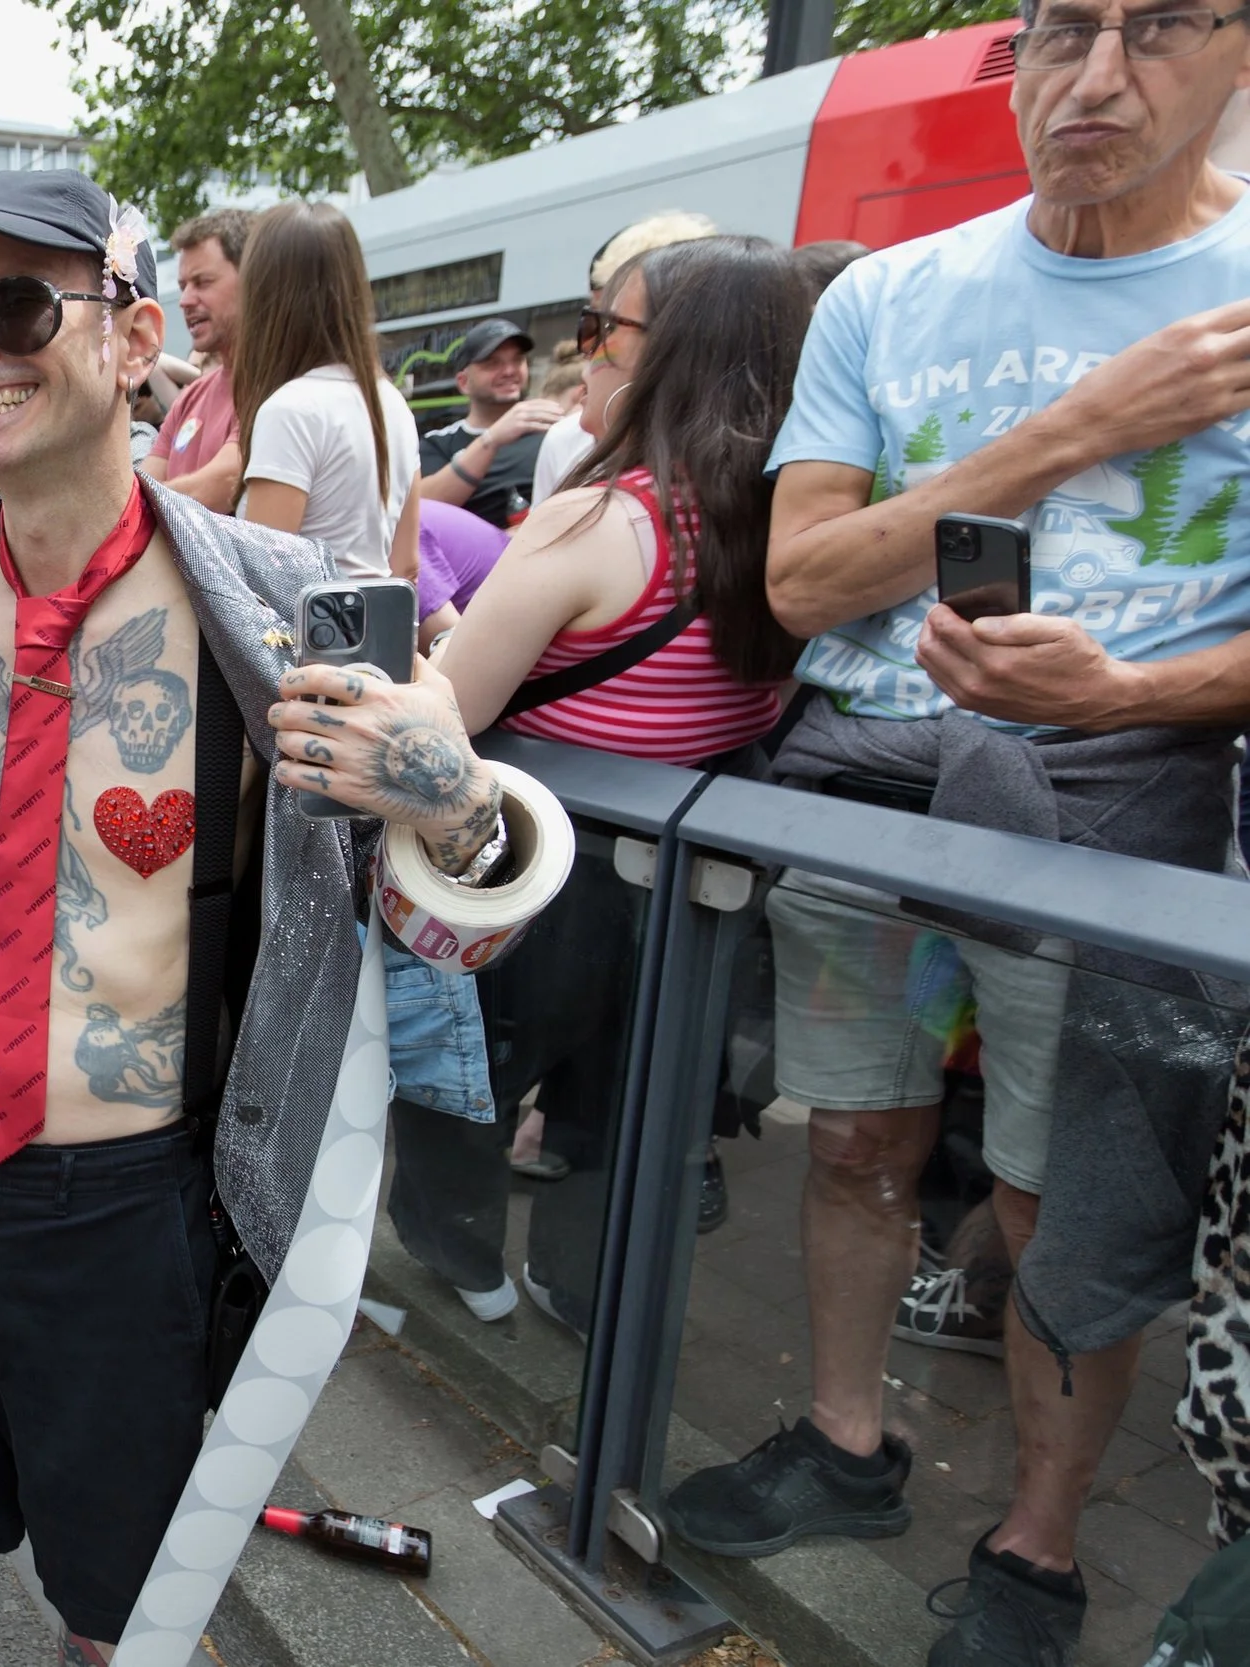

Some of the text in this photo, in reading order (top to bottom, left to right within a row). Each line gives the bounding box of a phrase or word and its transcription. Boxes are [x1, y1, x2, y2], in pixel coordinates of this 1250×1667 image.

[807, 638, 889, 701] ZUM
[10, 691, 33, 715] ARTEI
[16, 788, 46, 816] PARTEI
[23, 837, 52, 866] PARTEI
[8, 1023, 38, 1052] PARTEI
[16, 1070, 47, 1099] PARTEI
